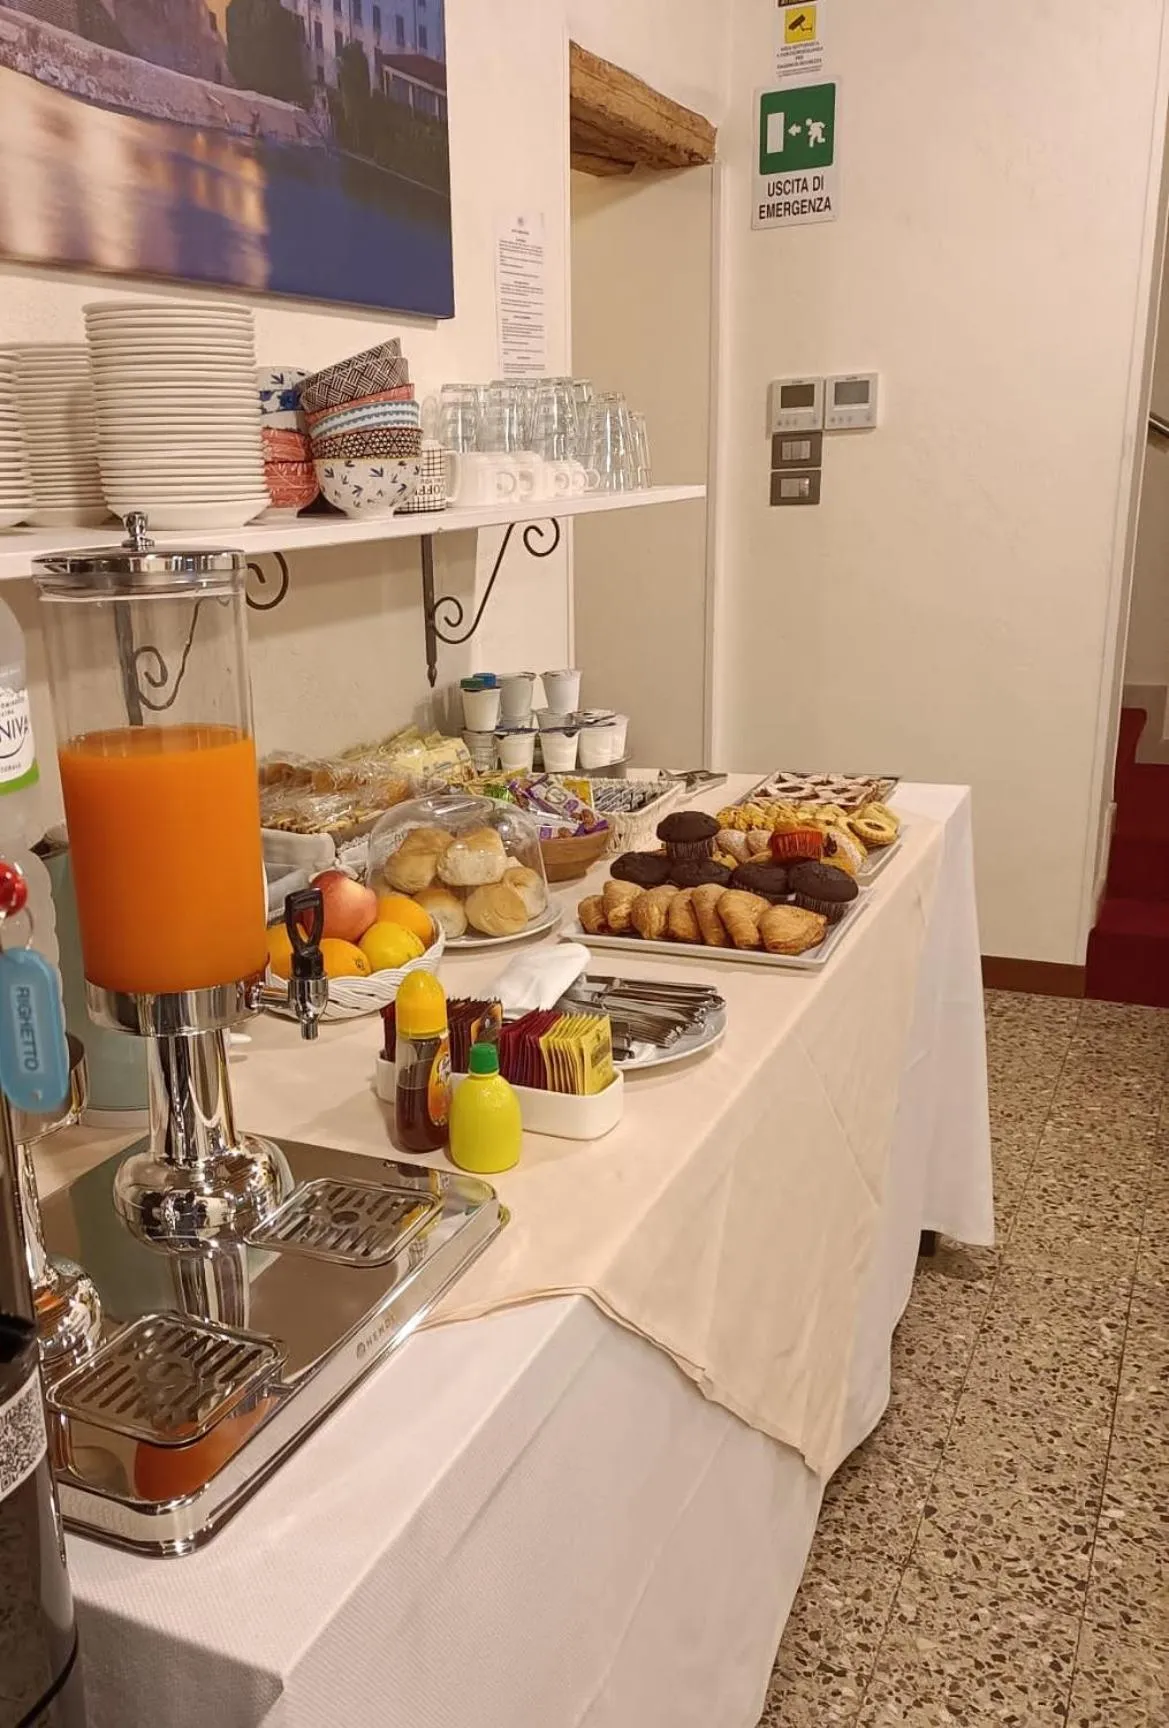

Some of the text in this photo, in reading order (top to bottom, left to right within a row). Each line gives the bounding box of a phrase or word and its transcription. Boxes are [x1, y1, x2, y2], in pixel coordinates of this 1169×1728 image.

[767, 174, 824, 197] USCITA DI
[758, 196, 832, 219] EMERGENZA
[415, 484, 446, 496] COFF
[16, 986, 39, 1072] RIGHETTO
